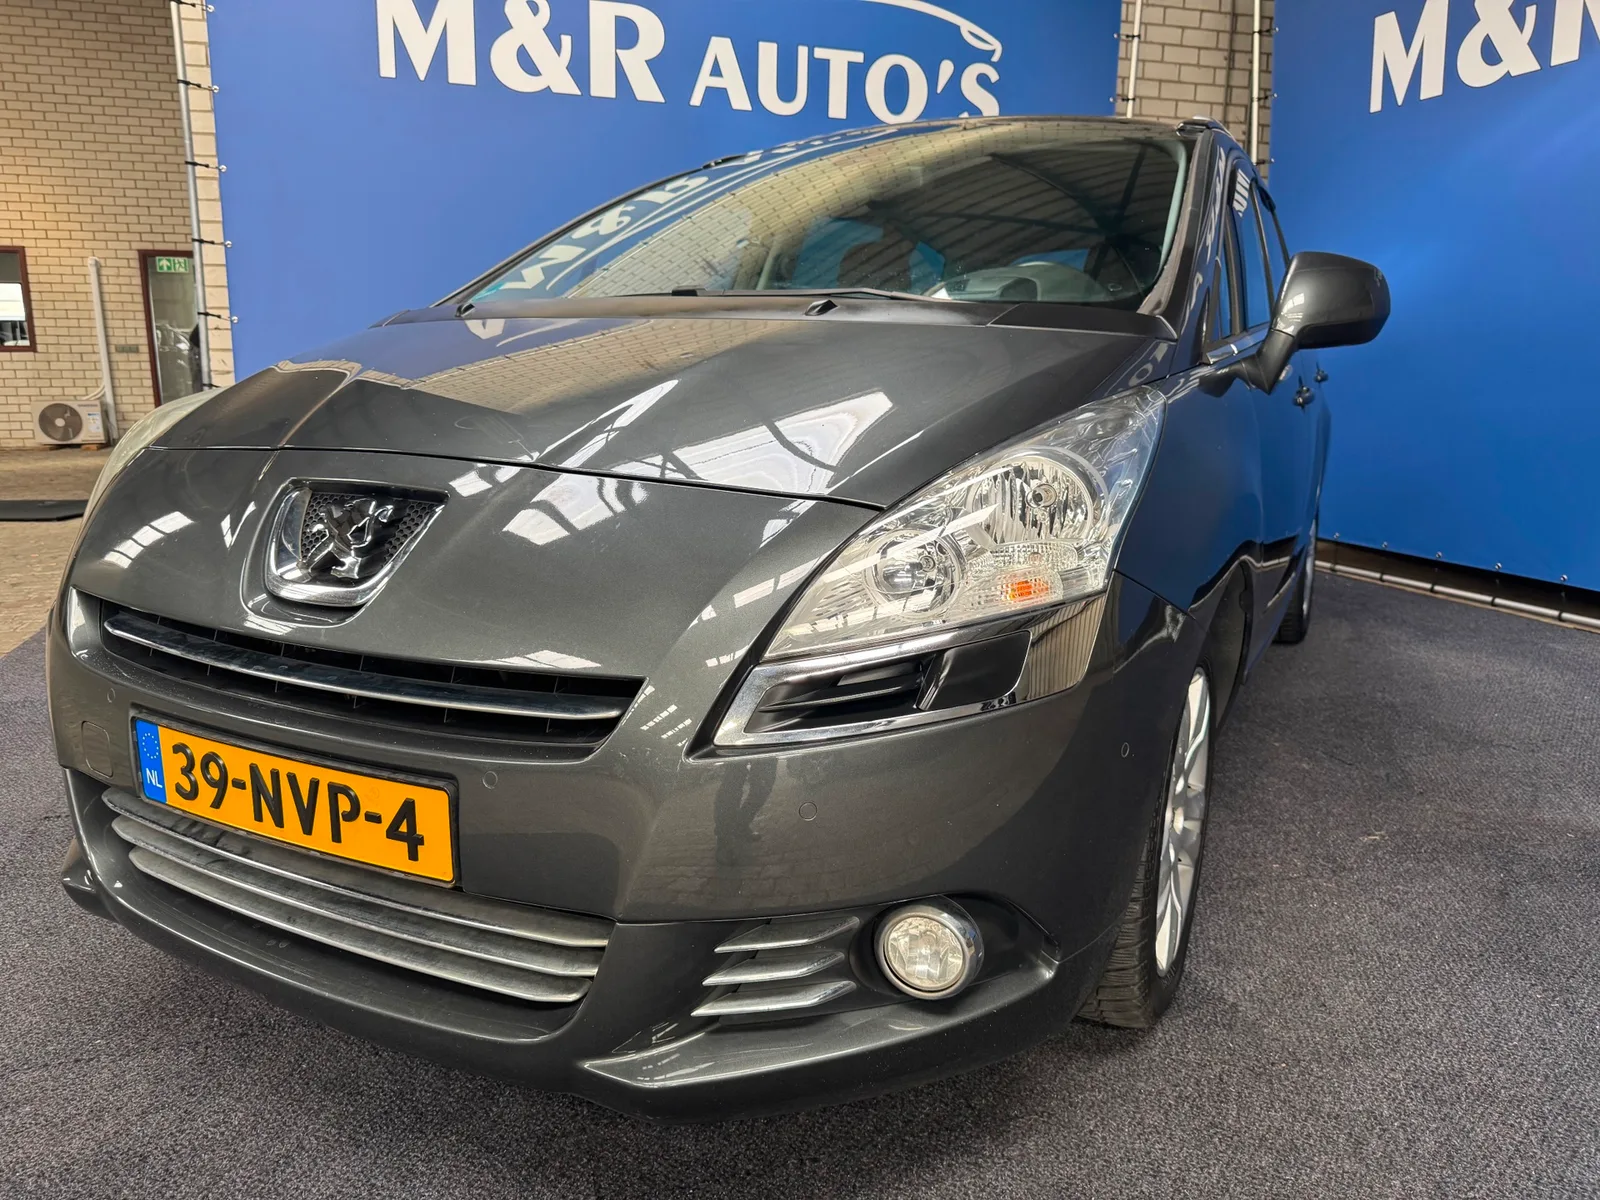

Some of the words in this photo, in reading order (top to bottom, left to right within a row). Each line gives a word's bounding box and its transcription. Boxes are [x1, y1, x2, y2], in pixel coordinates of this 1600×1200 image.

[375, 0, 666, 104] M&R
[689, 36, 1000, 125] AUTO'S
[145, 767, 163, 789] NL
[171, 742, 425, 862] 39-NVP-4
